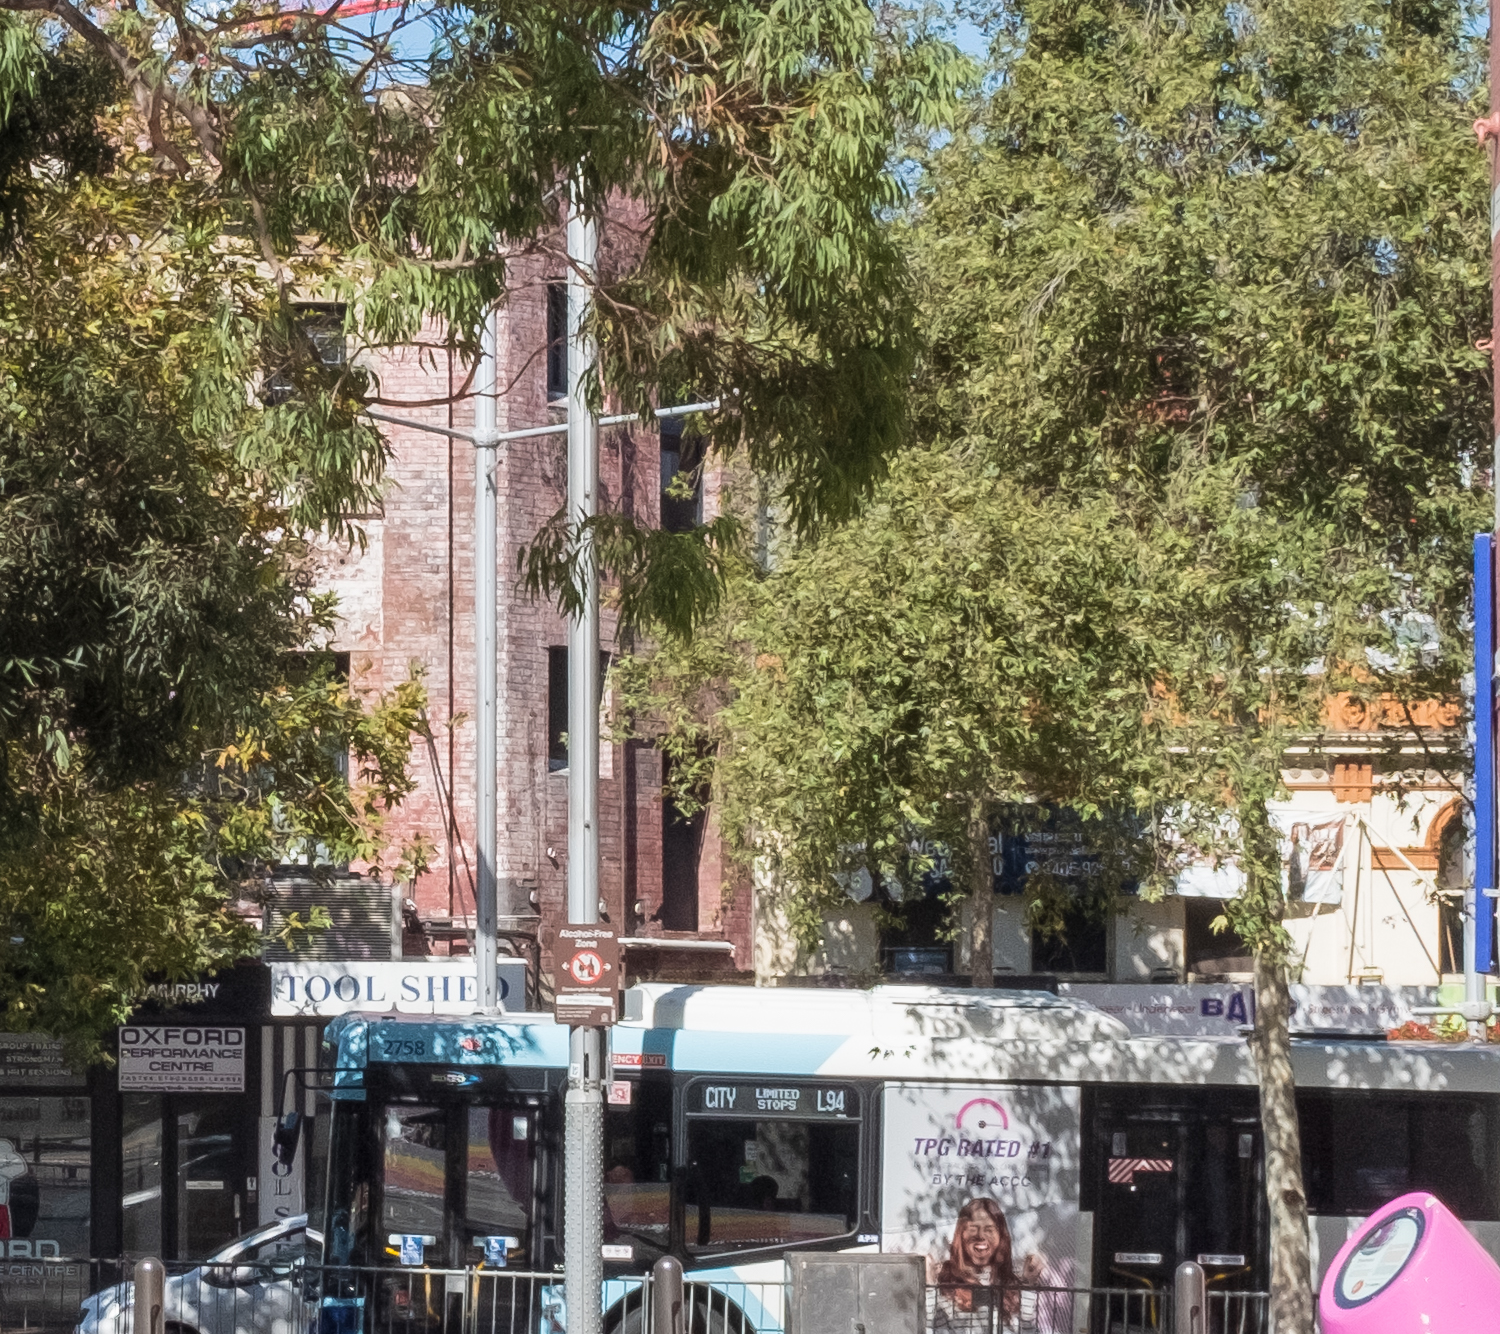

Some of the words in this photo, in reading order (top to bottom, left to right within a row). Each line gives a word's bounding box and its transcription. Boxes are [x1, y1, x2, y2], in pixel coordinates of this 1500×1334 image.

[574, 939, 598, 948] Zone
[281, 974, 386, 1002] TOOL
[120, 1028, 243, 1046] OXFORD
[120, 1048, 243, 1060] PERFORMANCE
[383, 1039, 426, 1056] 2758
[148, 1061, 214, 1072] CENTRE
[705, 1086, 737, 1109] CITY
[755, 1088, 800, 1099] LIMITED
[816, 1090, 845, 1112] L94
[757, 1100, 797, 1111] STOPS
[914, 1137, 952, 1156] TPG
[956, 1139, 1021, 1158] RATED
[932, 1173, 954, 1185] BY
[956, 1174, 986, 1186] THE
[988, 1175, 1032, 1188] ACCC
